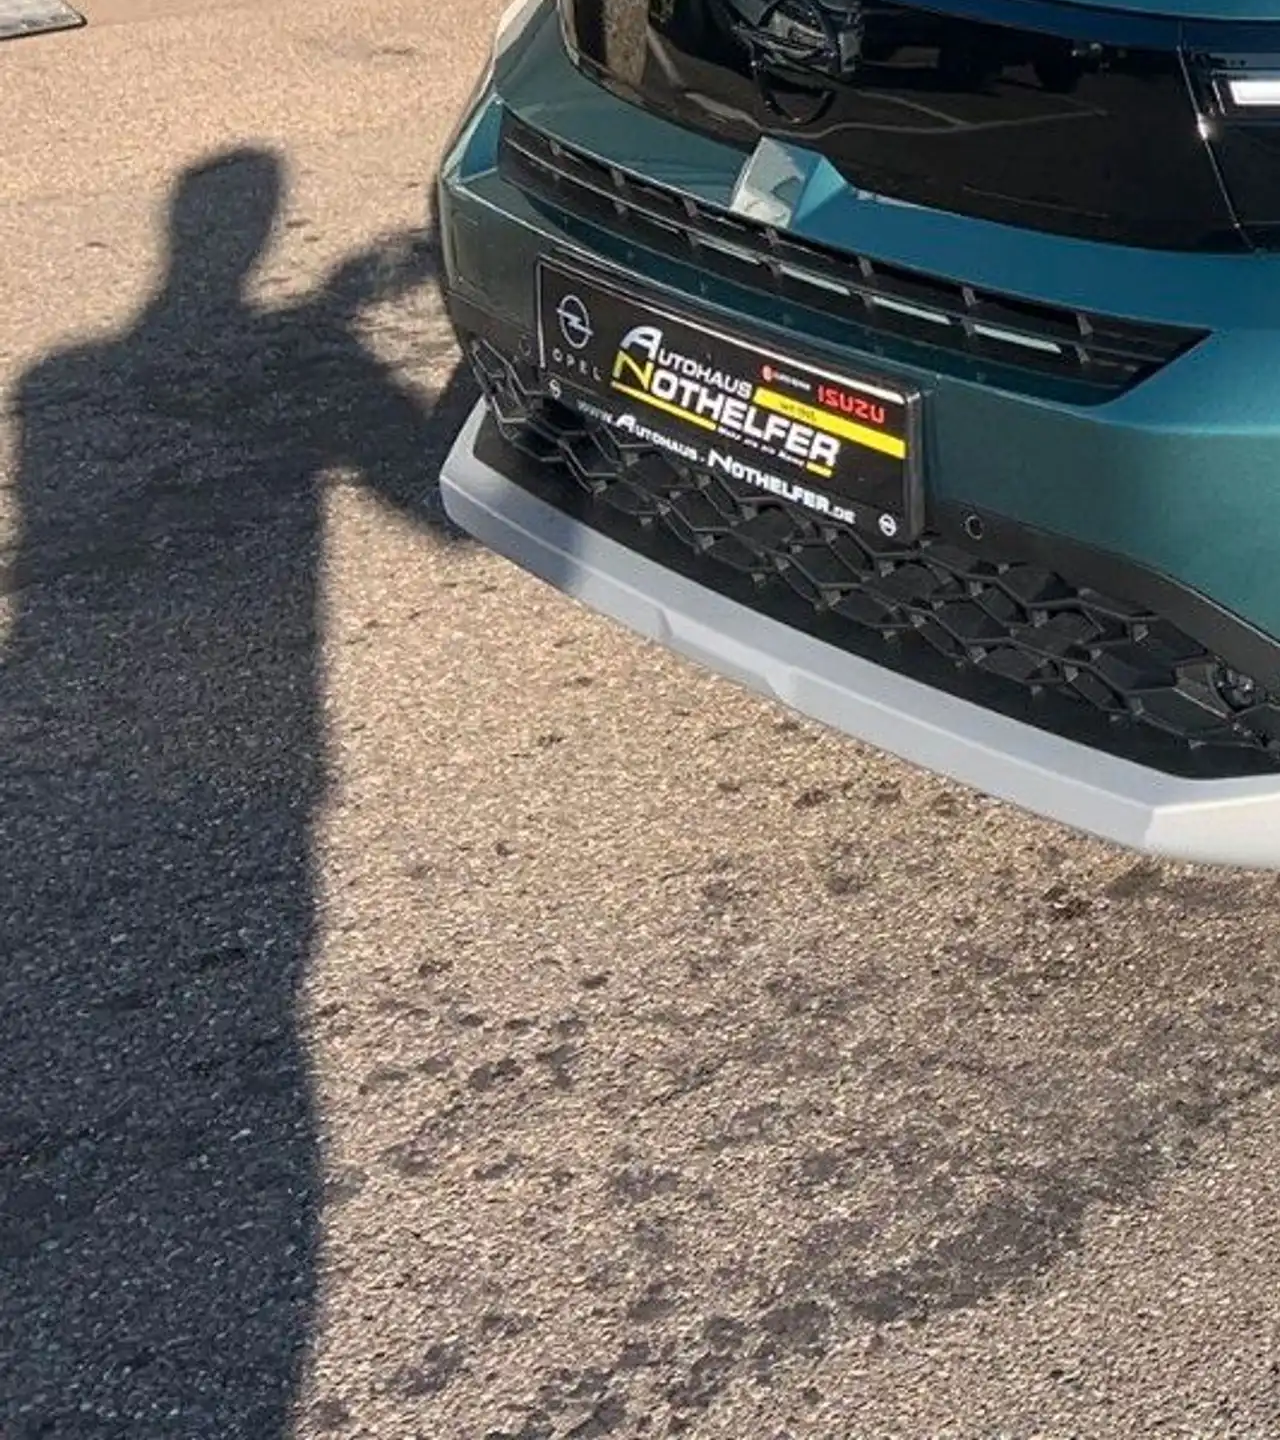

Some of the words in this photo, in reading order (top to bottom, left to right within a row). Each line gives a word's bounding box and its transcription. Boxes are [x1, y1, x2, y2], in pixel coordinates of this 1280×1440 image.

[551, 347, 602, 382] OPEL
[620, 326, 754, 397] AUTOHAUS
[612, 349, 842, 467] NOTHELFER
[817, 384, 886, 425] ISUZU
